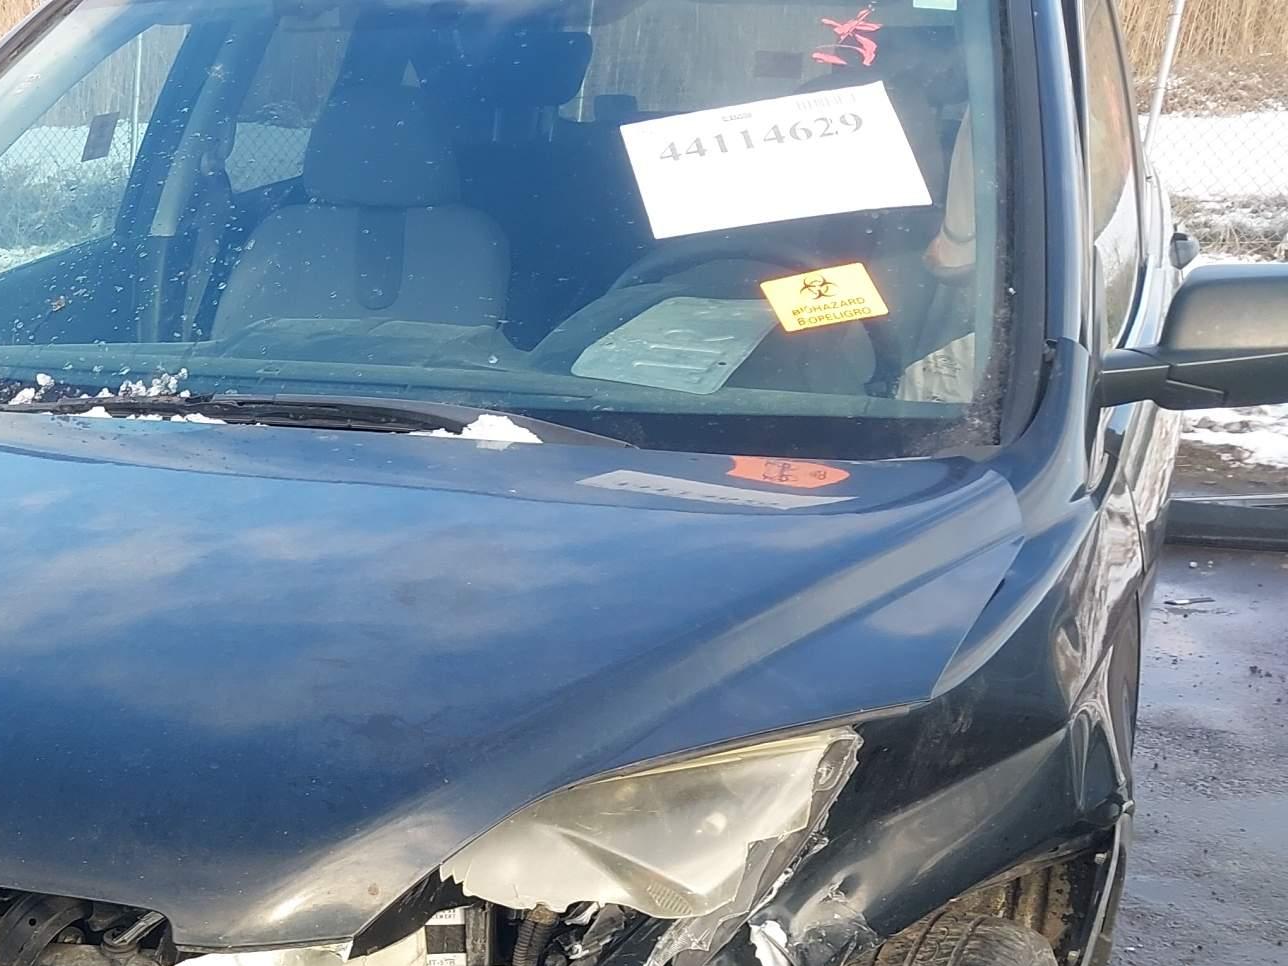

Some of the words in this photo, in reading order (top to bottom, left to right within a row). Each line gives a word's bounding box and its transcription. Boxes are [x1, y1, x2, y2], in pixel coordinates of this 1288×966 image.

[659, 112, 864, 161] 44114629
[792, 297, 865, 316] BIOHAZARD
[797, 307, 872, 326] BOPELIGRO
